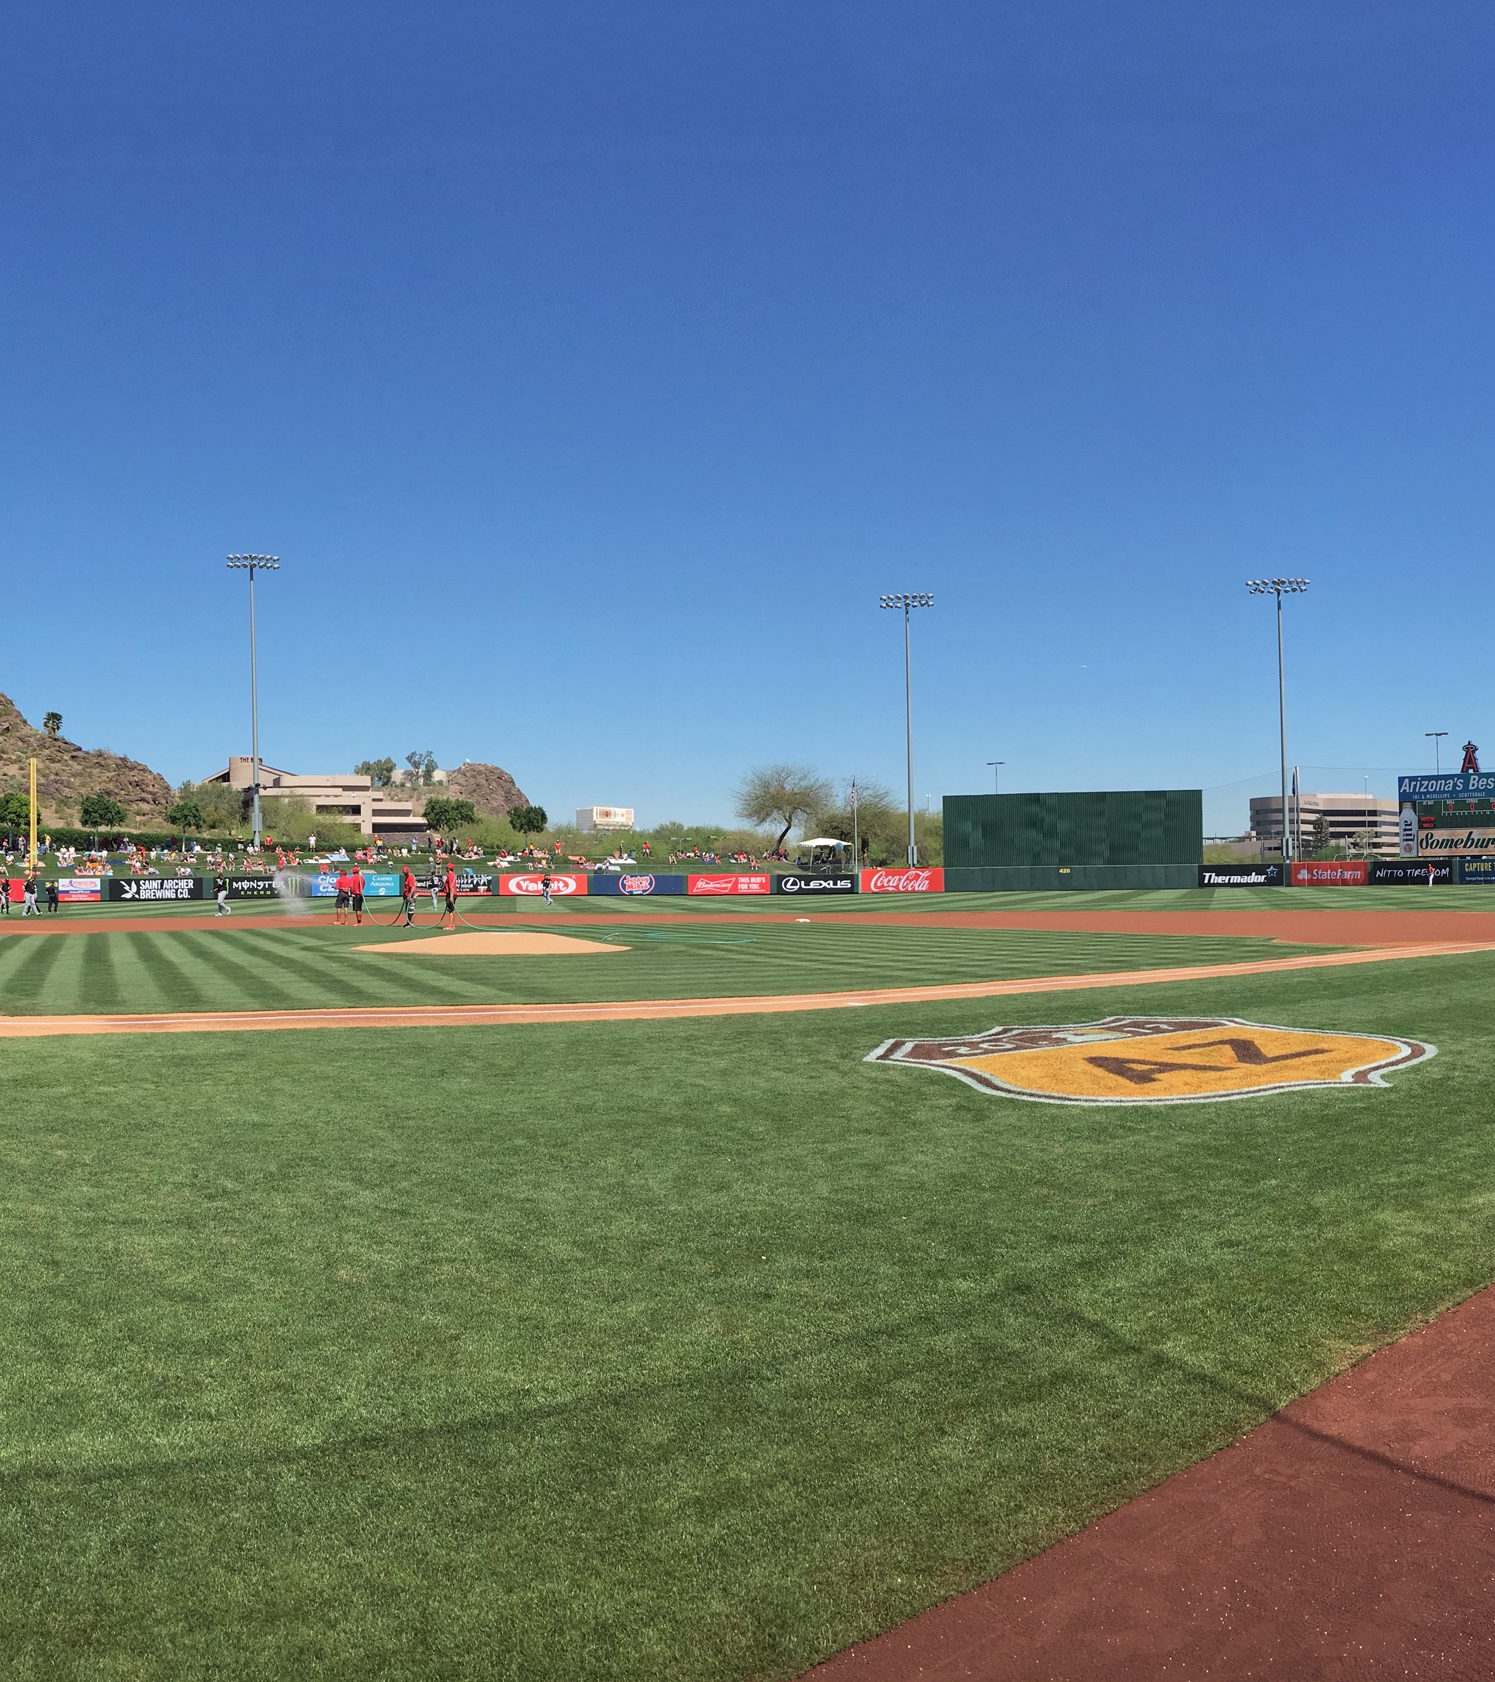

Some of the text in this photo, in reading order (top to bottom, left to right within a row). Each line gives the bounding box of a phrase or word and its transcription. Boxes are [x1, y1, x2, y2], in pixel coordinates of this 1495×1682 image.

[1400, 778, 1464, 793] Arizona's
[1403, 820, 1415, 842] Lite
[1419, 831, 1495, 849] Somebur
[1376, 867, 1404, 878] NITTO
[1464, 862, 1492, 872] CAPTURE
[870, 870, 933, 892] Coca-Cola
[1202, 872, 1266, 883] Thermador
[140, 879, 193, 889] SAINT ARCHER
[232, 879, 285, 890] MONSTER
[519, 880, 567, 891] Yaklt
[801, 879, 852, 889] LEXUS
[140, 889, 191, 899] BREWING CO.
[1082, 1037, 1333, 1085] AZ
